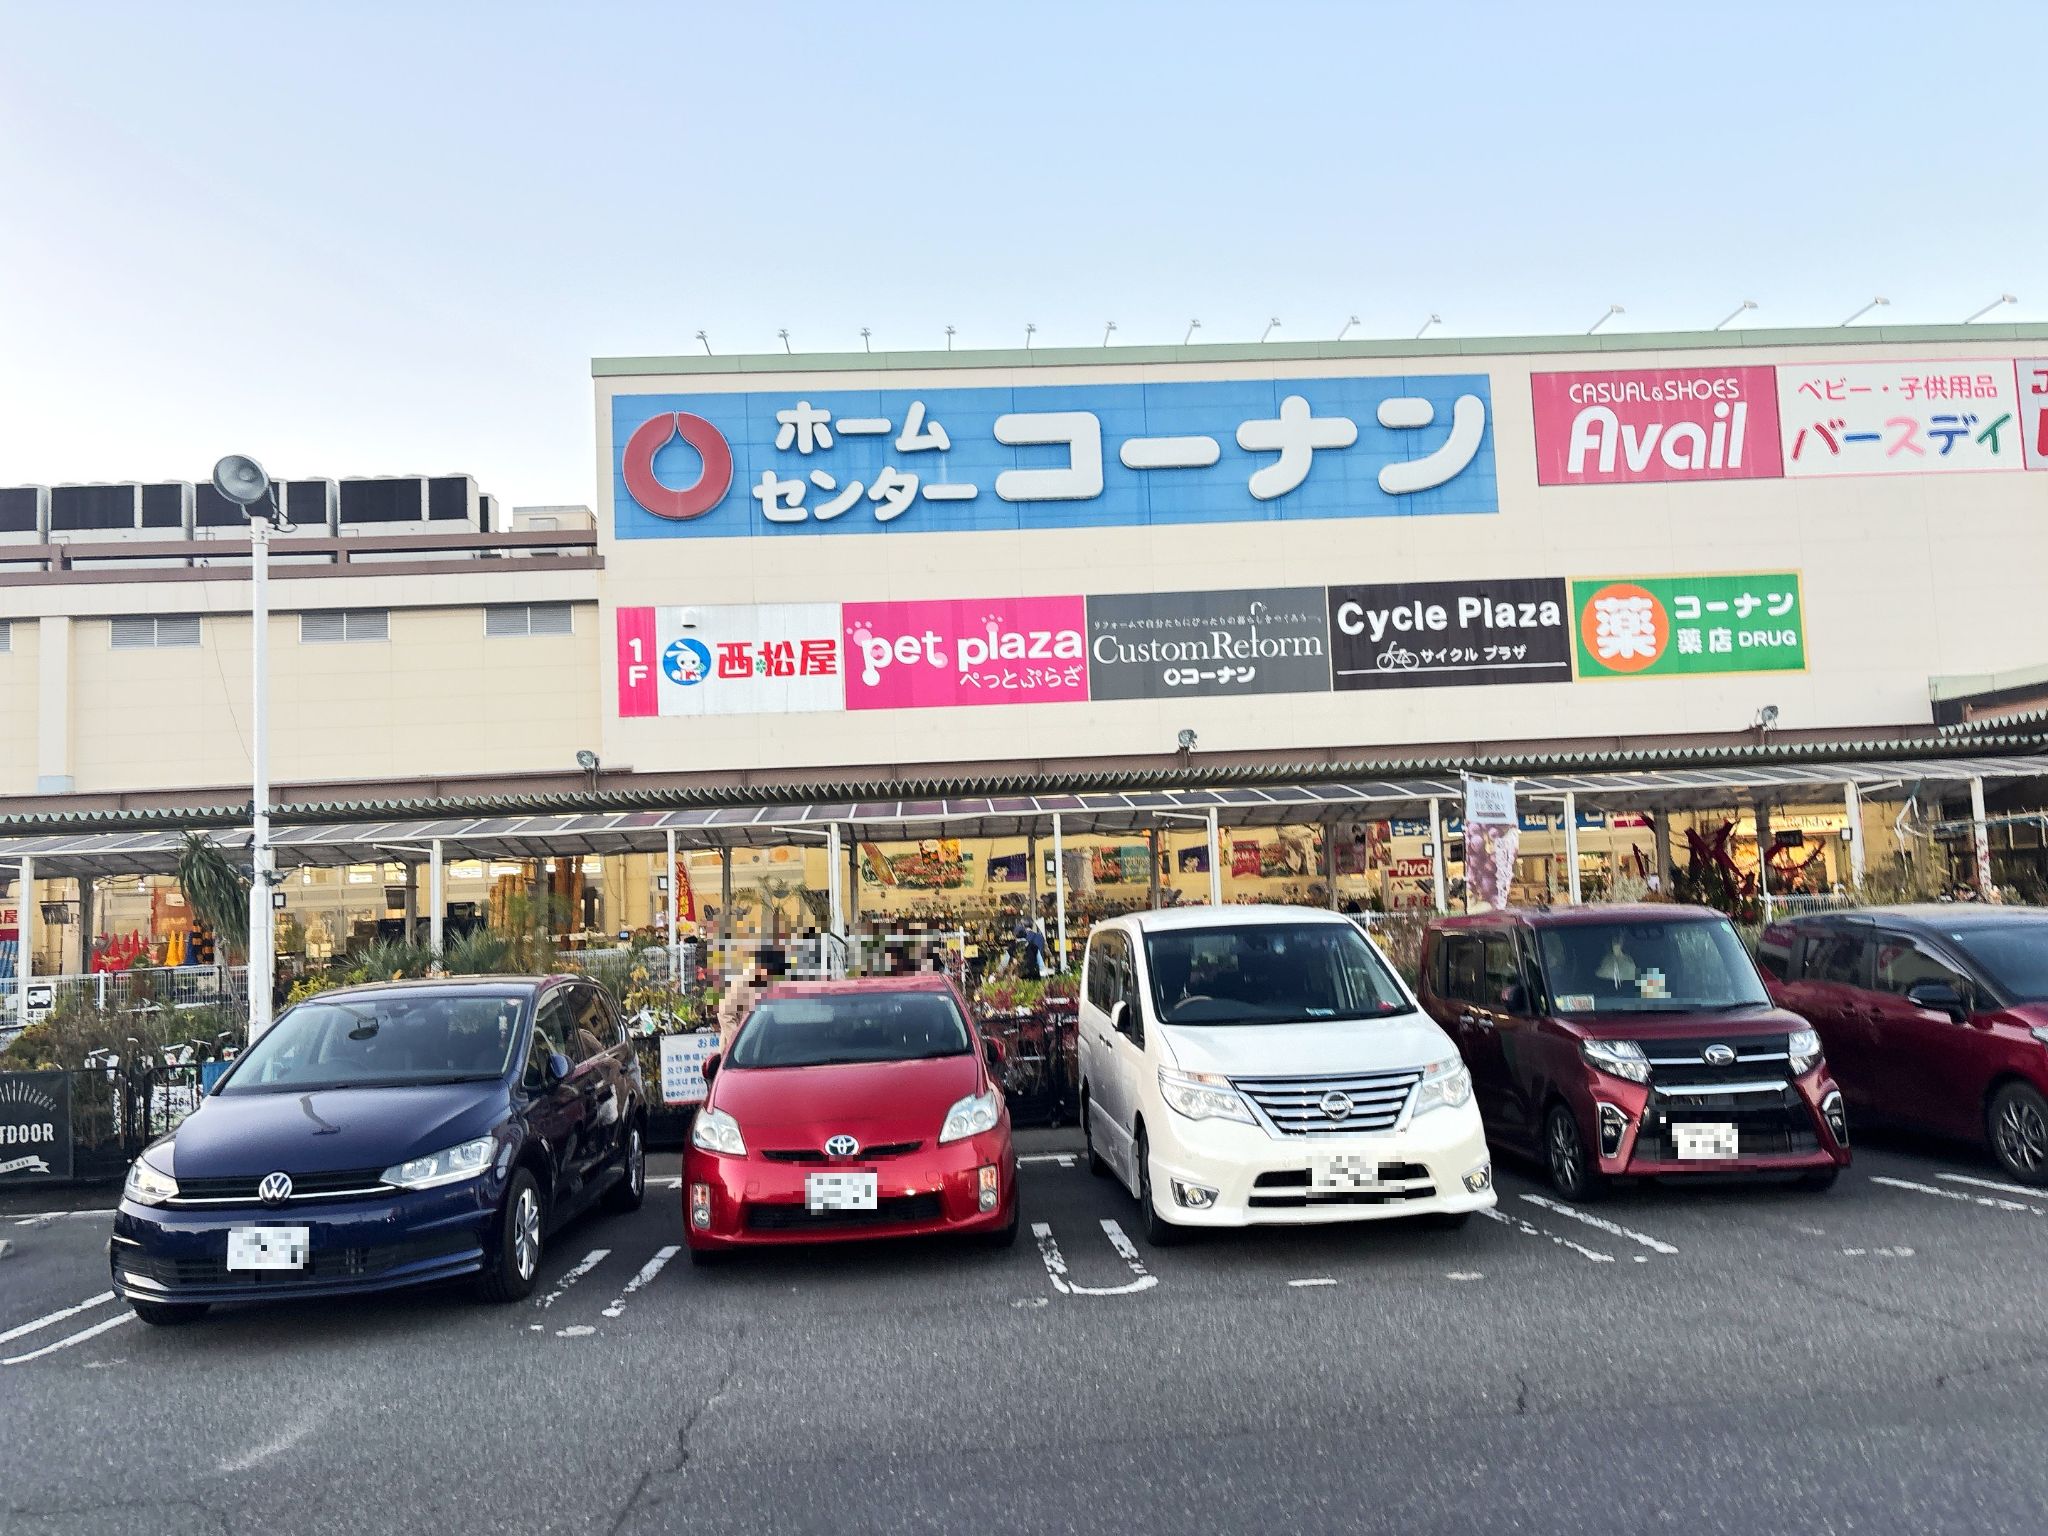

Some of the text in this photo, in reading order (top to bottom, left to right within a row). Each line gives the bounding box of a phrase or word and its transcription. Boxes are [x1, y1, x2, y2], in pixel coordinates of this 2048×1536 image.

[1569, 378, 1740, 403] CASUAL&SHOES
[1797, 375, 1998, 400] ベビー・子供用品
[775, 400, 951, 455] ホーム
[993, 394, 1486, 502] コーナン
[1567, 401, 1748, 474] Avail
[1791, 411, 2013, 461] バースデイ
[752, 466, 979, 523] センター
[1337, 596, 1561, 643] Cycle Plaza
[1674, 591, 1795, 620] コーナン
[1594, 595, 1657, 660] 薬
[1677, 628, 1797, 655] 薬店 DRUG
[716, 639, 839, 680] 西松屋
[861, 625, 1084, 687] pet plaza
[1421, 644, 1527, 664] サイクル プラザ
[958, 663, 1086, 690] ぺっとぷらざ
[1181, 666, 1256, 685] コーナン
[1397, 861, 1433, 876] Avai
